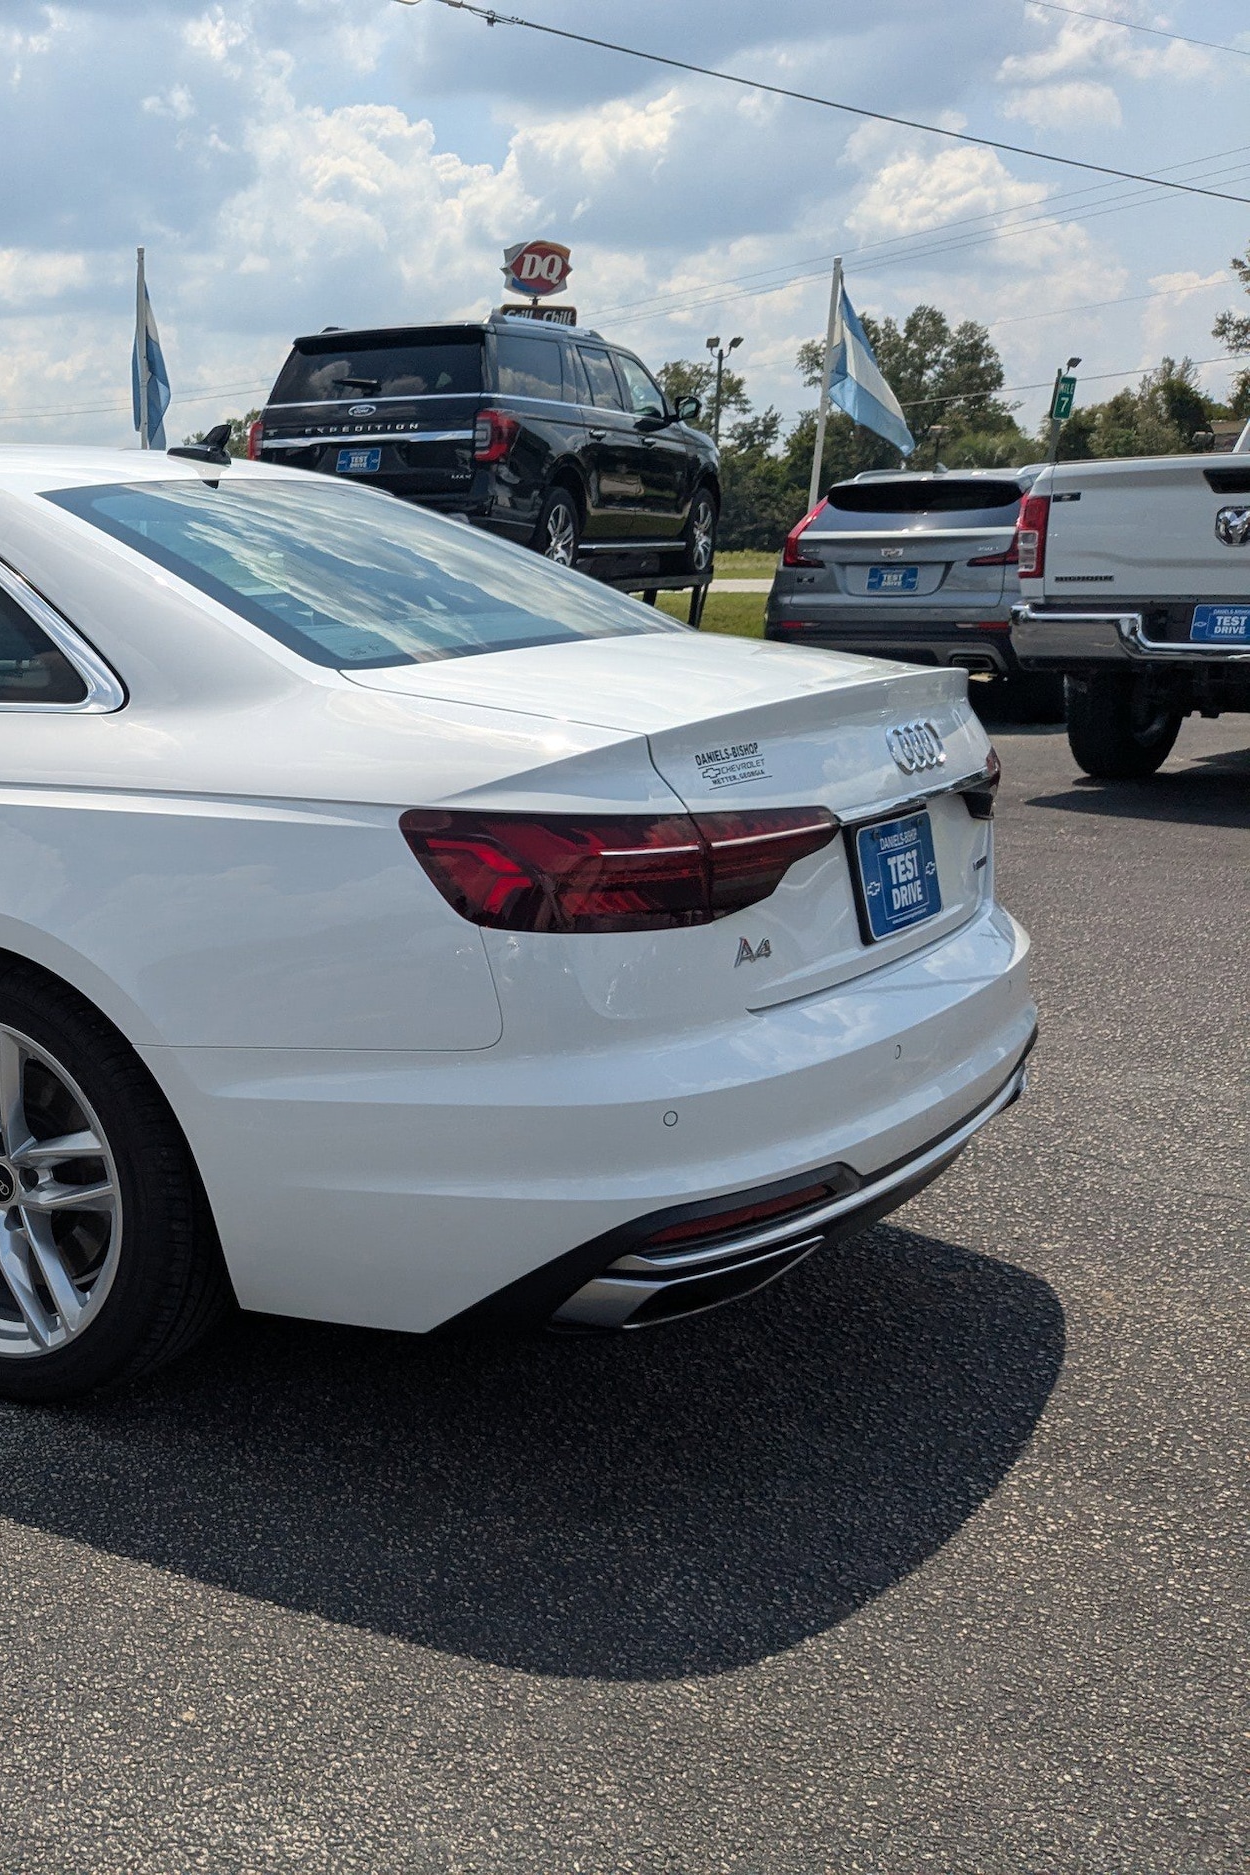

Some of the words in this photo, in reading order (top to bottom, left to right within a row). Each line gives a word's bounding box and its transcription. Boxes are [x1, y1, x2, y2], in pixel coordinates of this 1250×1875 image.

[520, 254, 562, 284] DQ
[543, 311, 572, 325] Chill
[1058, 382, 1075, 394] MILE
[1061, 397, 1069, 412] 7
[304, 423, 420, 435] EXPEDITION
[1216, 616, 1248, 626] TEST
[1214, 625, 1246, 634] DRIVE
[695, 742, 758, 766] DANIELS-BISHOP
[721, 759, 765, 774] CHEVROLET
[739, 769, 765, 779] GEORGIA
[887, 849, 919, 885] TEST
[892, 880, 923, 910] DRIVE
[733, 936, 772, 968] A4
